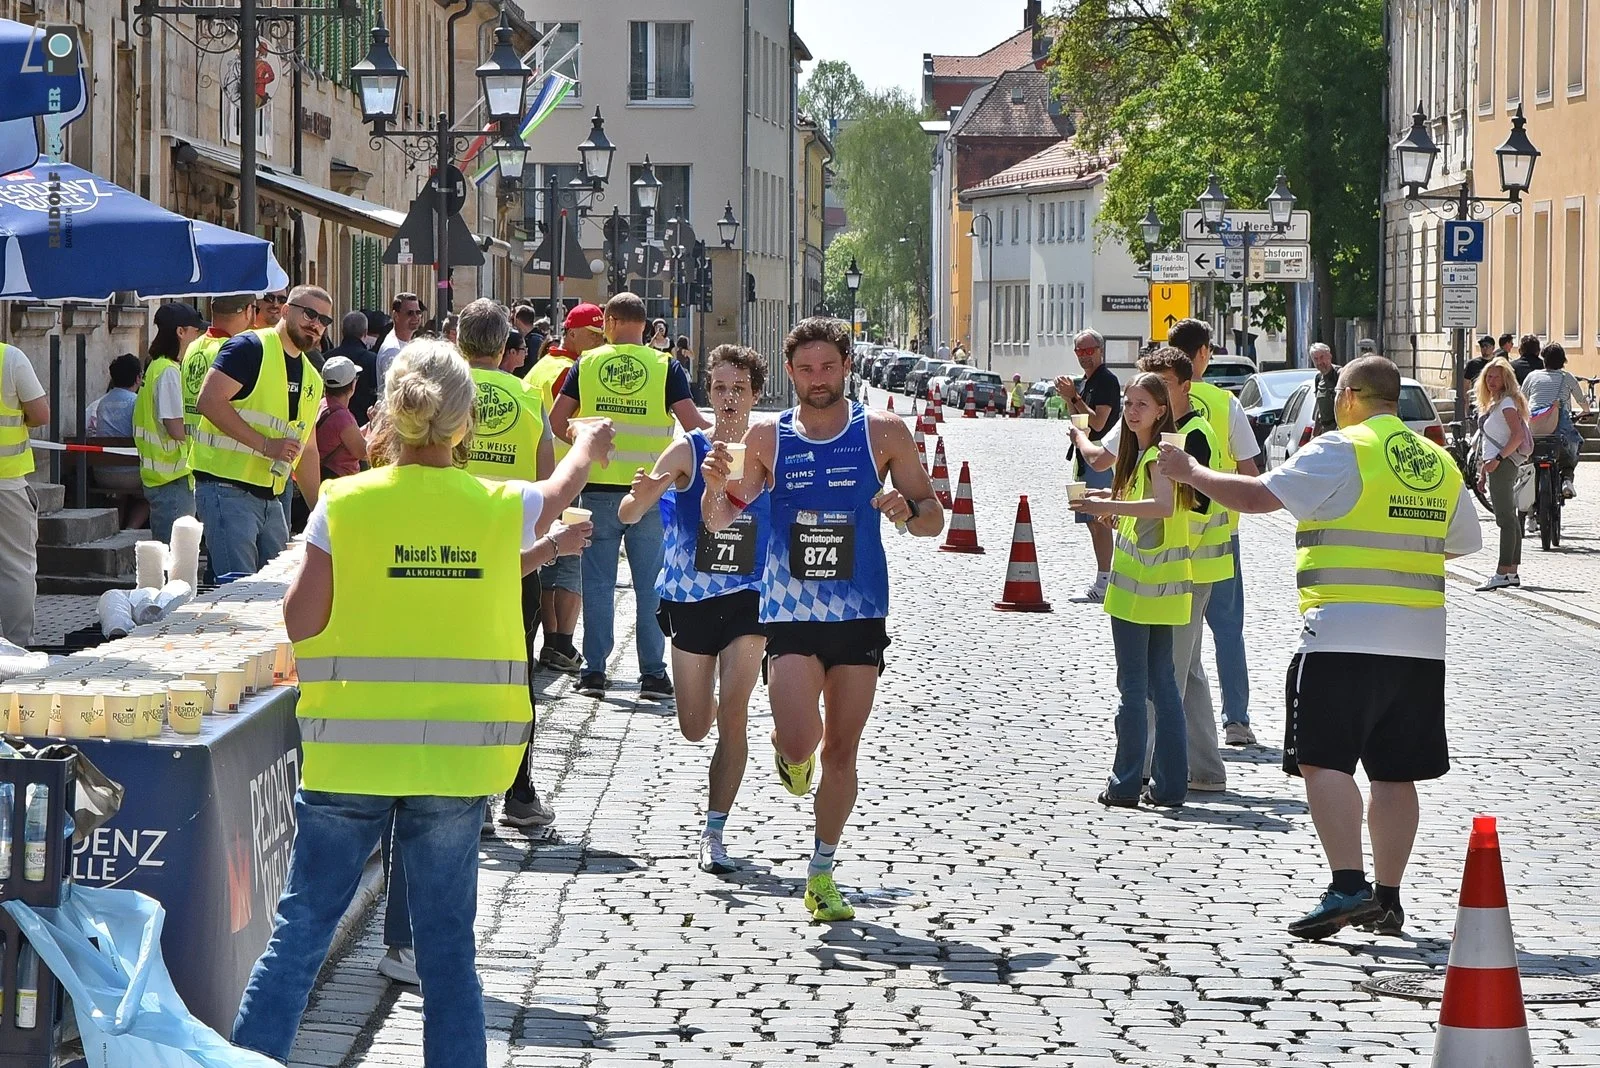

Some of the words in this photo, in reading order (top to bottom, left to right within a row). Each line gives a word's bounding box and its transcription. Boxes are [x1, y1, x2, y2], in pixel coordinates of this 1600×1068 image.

[0, 179, 112, 207] ESIDENZ
[1236, 222, 1275, 231] Uteres
[1264, 247, 1302, 258] chsforum
[1161, 287, 1172, 300] U
[477, 385, 500, 406] sel's
[596, 396, 624, 405] MAISEL'S
[626, 398, 648, 407] WEISSE
[598, 405, 644, 414] ALKOHOLFREI
[487, 441, 518, 453] WEISSE
[467, 451, 512, 463] OHOLFREI
[828, 479, 857, 487] bender
[1389, 494, 1424, 508] MAISEL'S
[1392, 509, 1445, 520] ALKOHOLFREI
[714, 531, 743, 541] Dominic
[800, 533, 844, 545] Christopher
[394, 544, 437, 564] Maisel's
[439, 545, 477, 564] Weisse
[717, 543, 735, 561] 71
[804, 546, 838, 565] 874
[405, 568, 467, 577] ALKOHOLFREI
[710, 563, 739, 573] cep
[805, 569, 837, 578] cep
[173, 706, 203, 714] RESIDENZ
